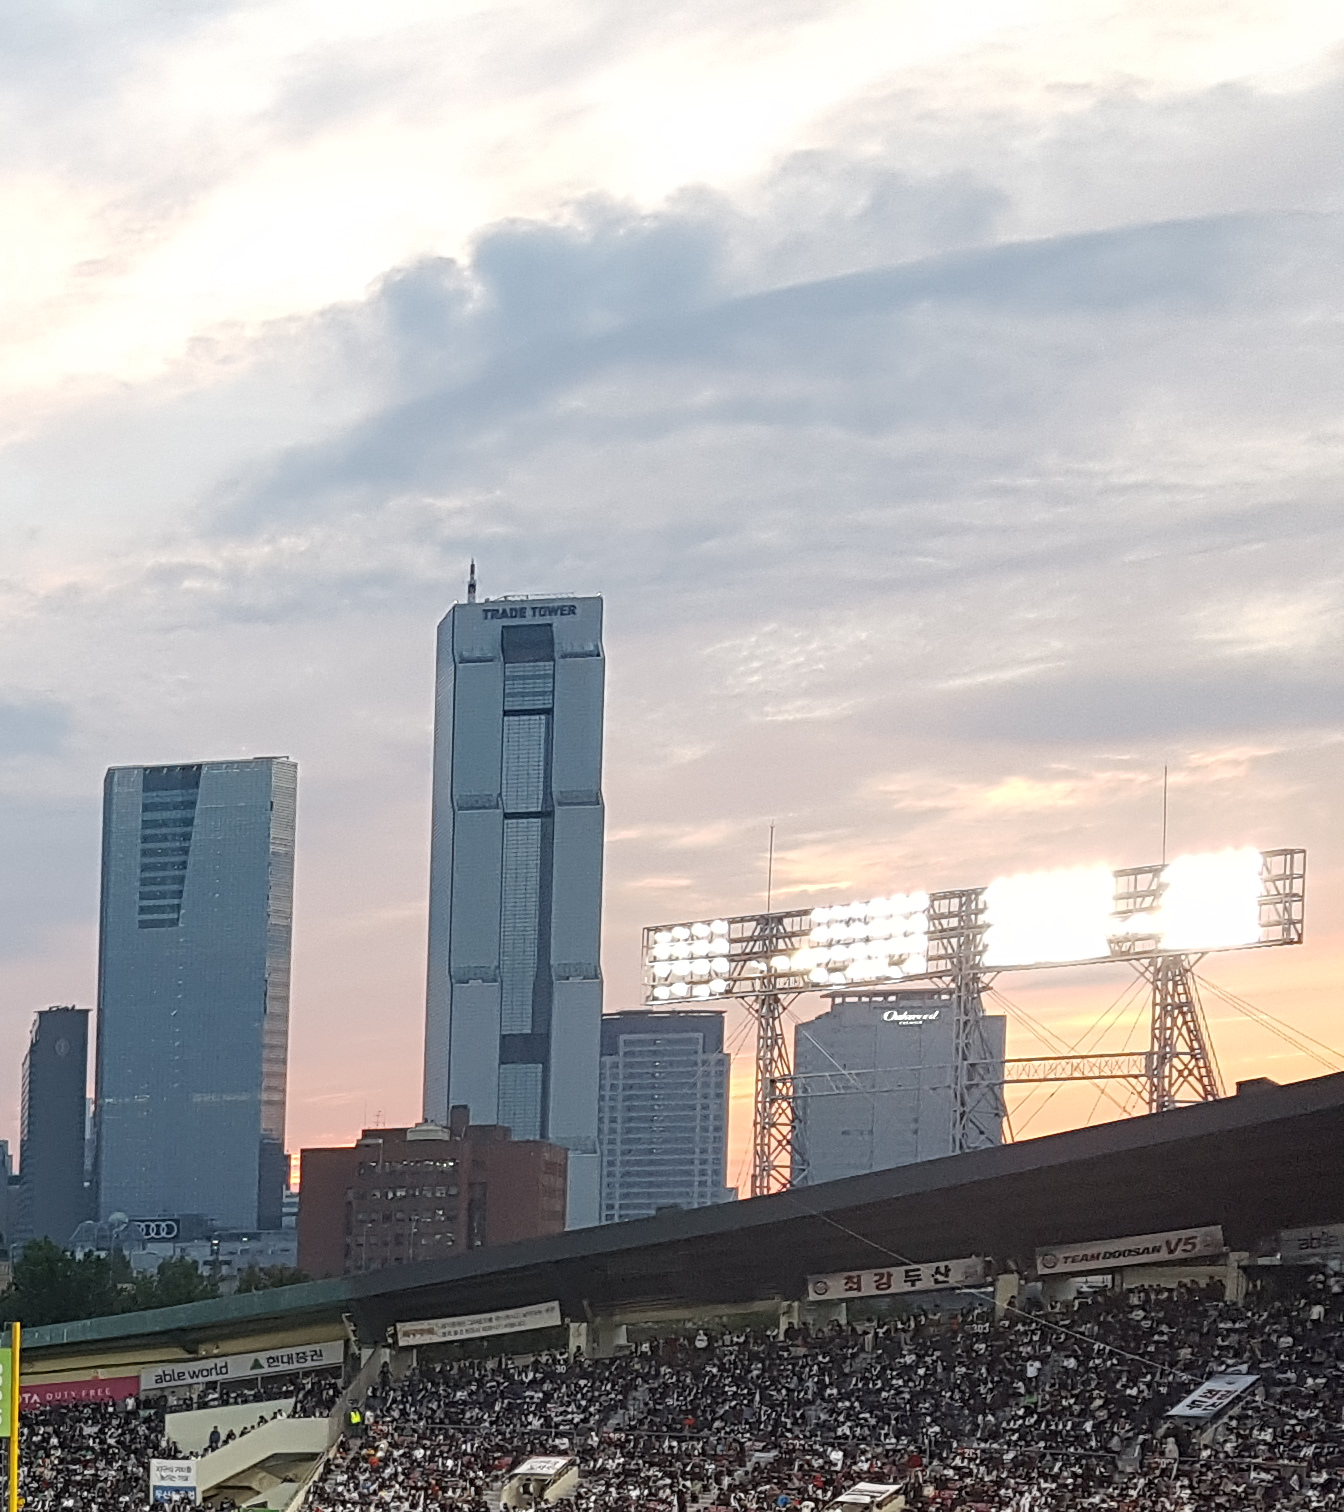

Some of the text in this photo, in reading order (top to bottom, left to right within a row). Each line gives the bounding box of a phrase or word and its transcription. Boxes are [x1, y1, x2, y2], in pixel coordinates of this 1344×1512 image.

[482, 604, 577, 620] TRADE TOWER
[1165, 1235, 1199, 1256] V5
[266, 1348, 324, 1368] 현대증권
[154, 1361, 229, 1384] able world
[82, 1387, 110, 1398] FREE
